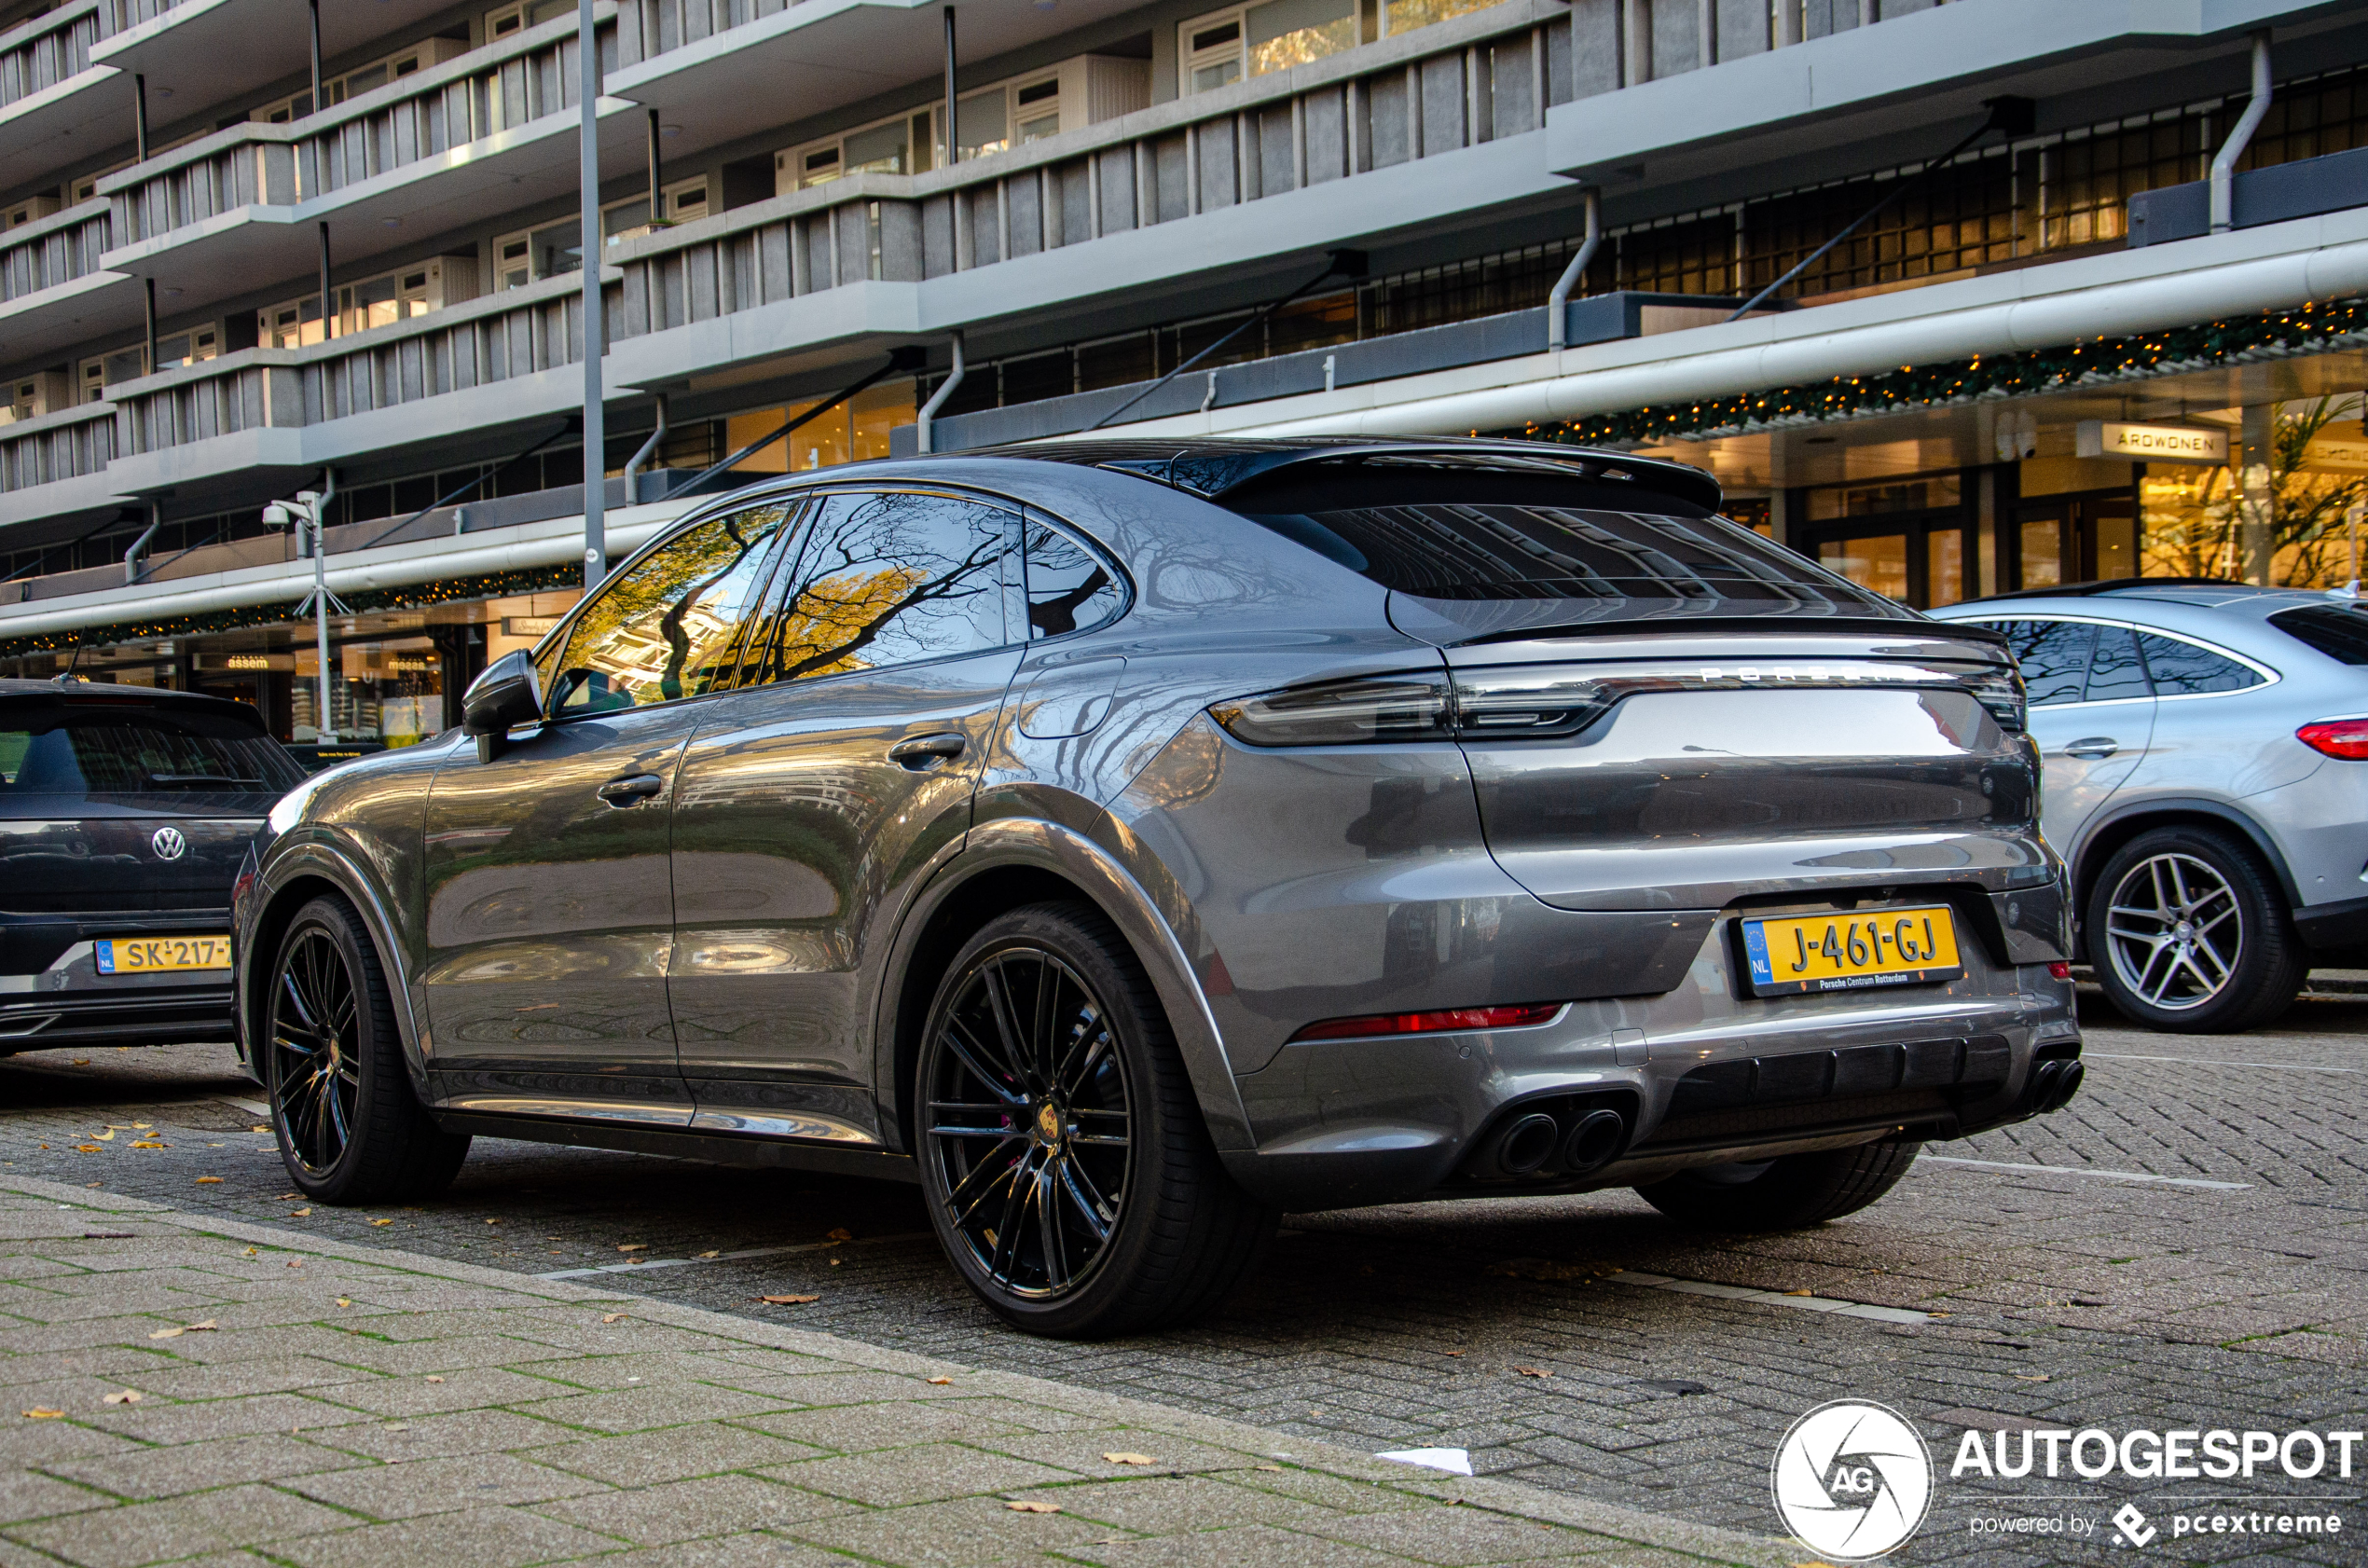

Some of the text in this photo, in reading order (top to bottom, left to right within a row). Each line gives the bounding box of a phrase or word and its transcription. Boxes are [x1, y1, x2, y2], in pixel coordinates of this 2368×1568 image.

[2117, 433, 2214, 451] AROWONEN
[227, 657, 269, 669] assem
[1792, 918, 1936, 971] J-461-GJ
[101, 959, 113, 968] NL
[1753, 959, 1769, 974] NL
[1820, 973, 1907, 989] Porsche Centrum Rotterdam
